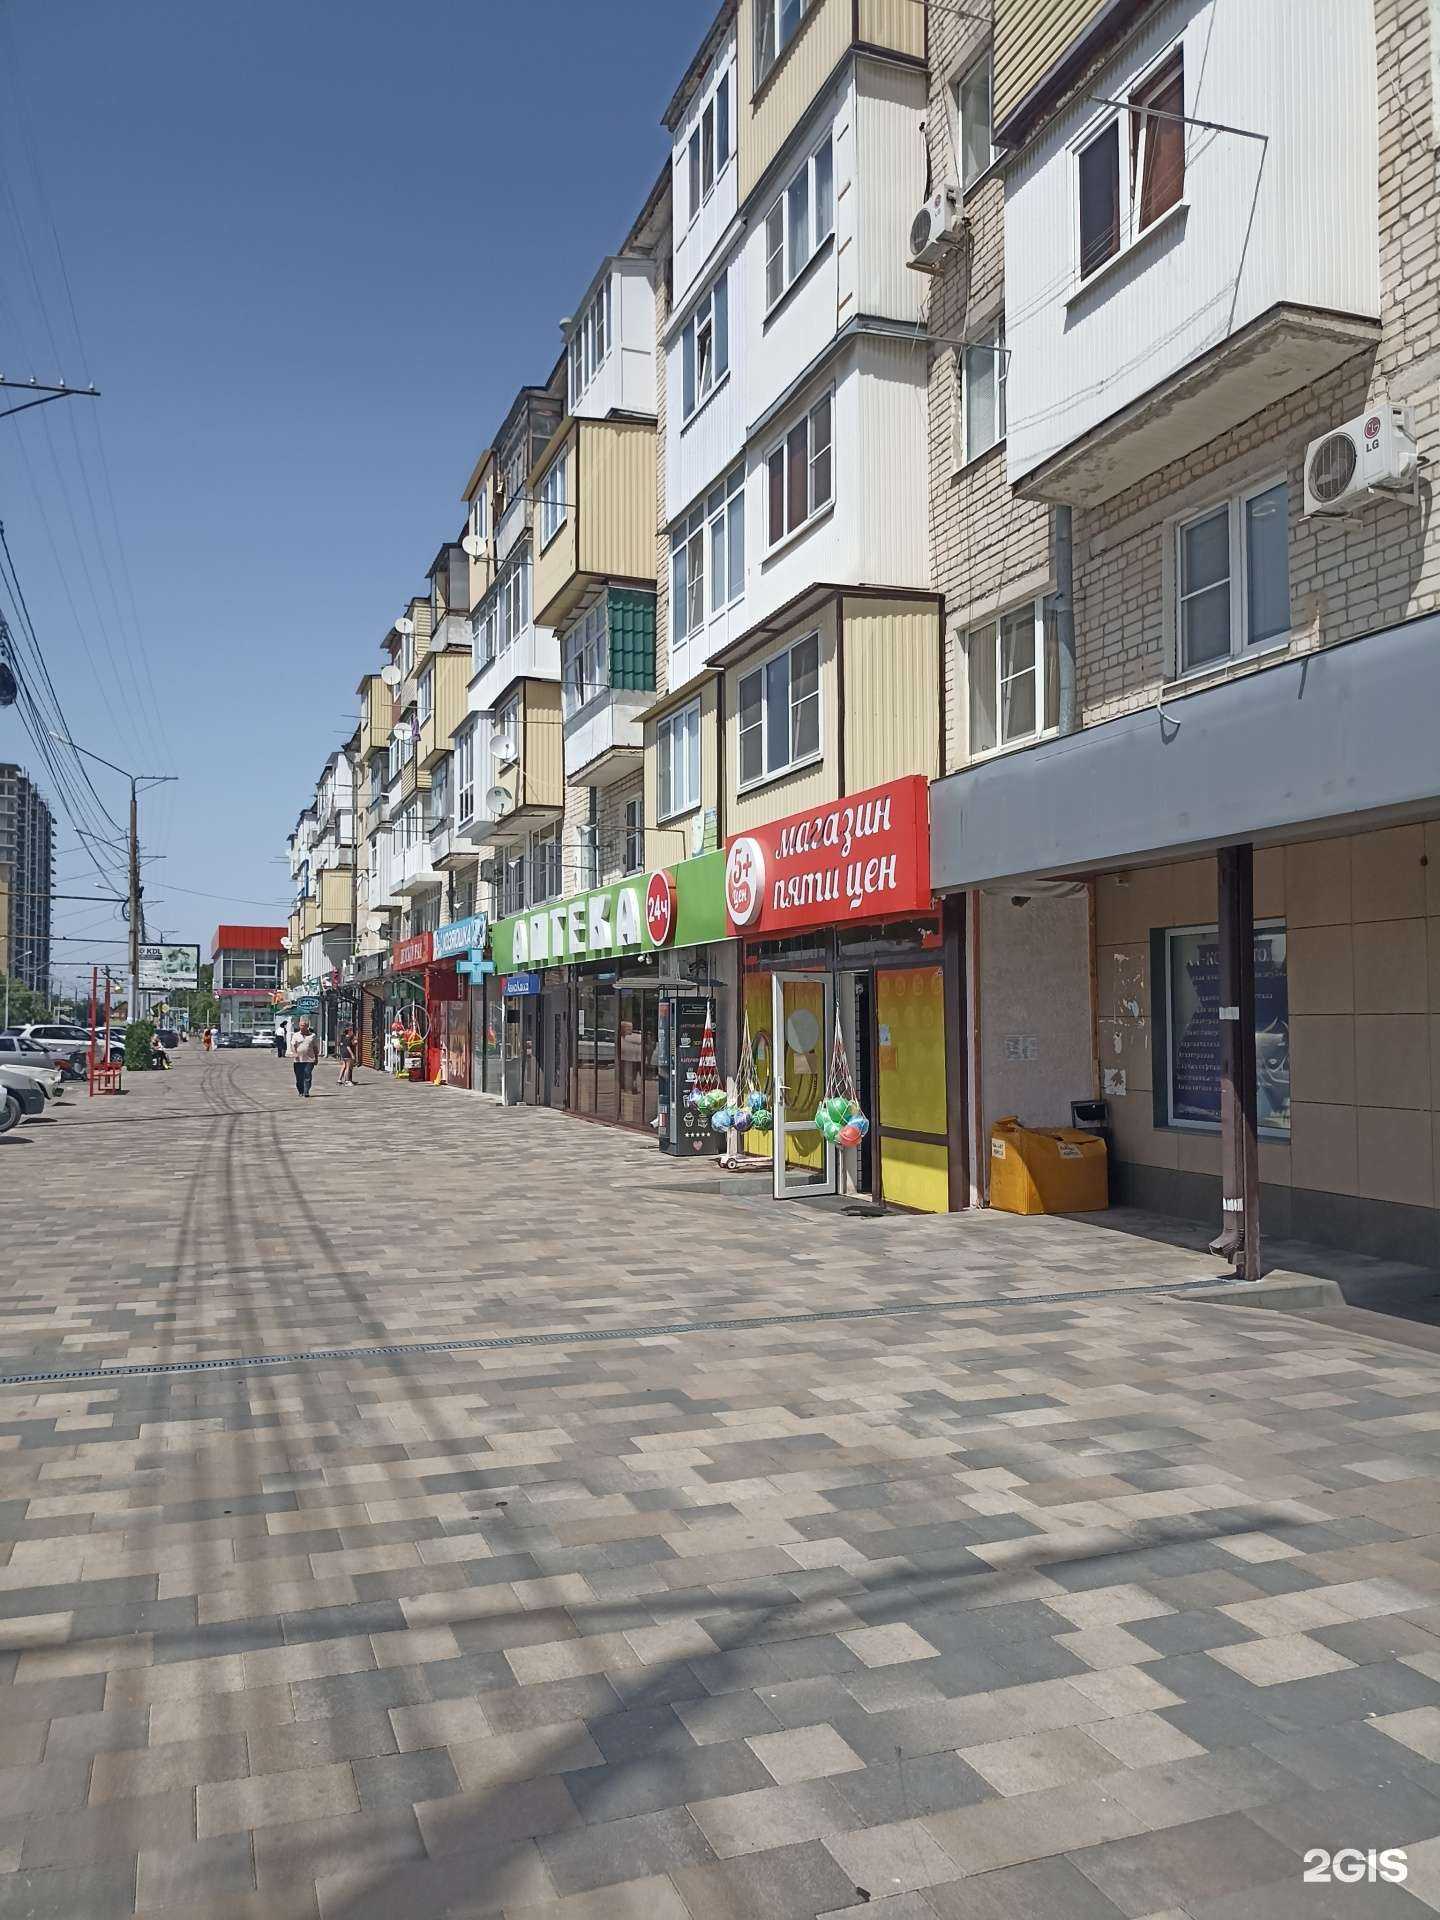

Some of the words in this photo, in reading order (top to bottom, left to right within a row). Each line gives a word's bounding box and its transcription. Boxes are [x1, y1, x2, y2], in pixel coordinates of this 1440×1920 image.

[1366, 440, 1380, 453] LG
[776, 796, 892, 857] магазин
[734, 848, 752, 884] 5+
[773, 866, 840, 910] пяти
[846, 854, 897, 911] цен
[513, 887, 642, 965] АПТЕКА
